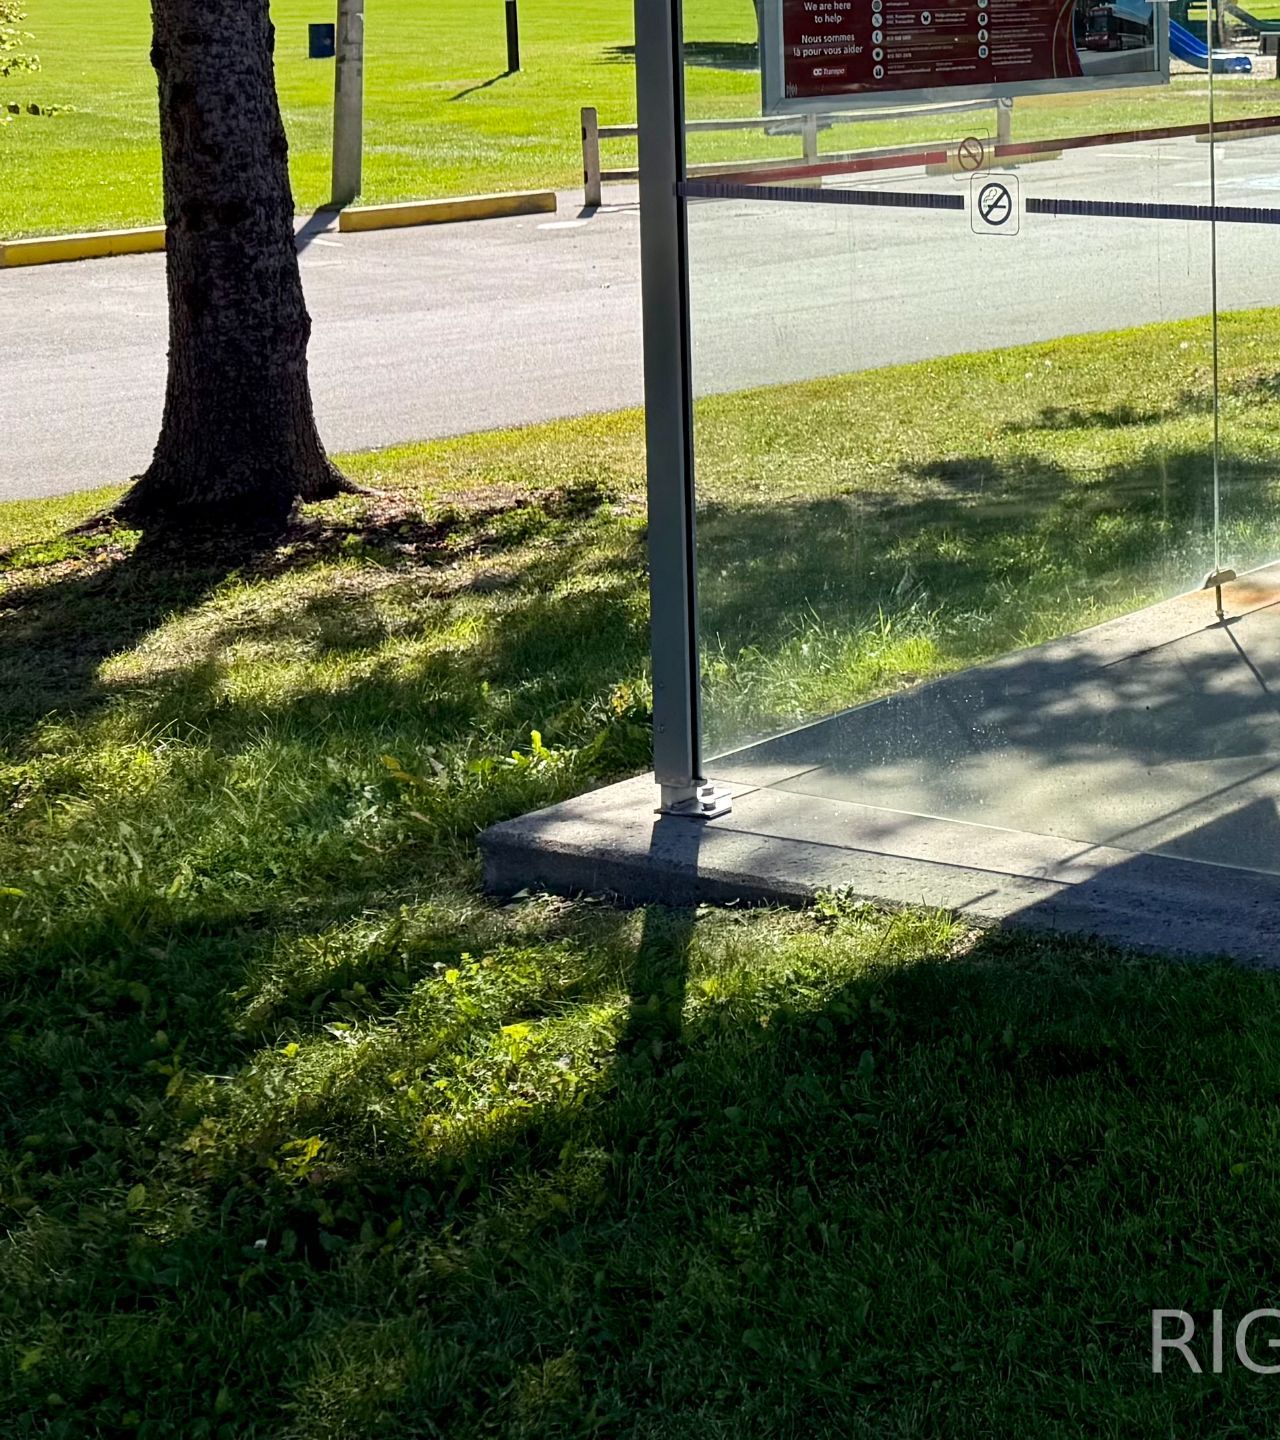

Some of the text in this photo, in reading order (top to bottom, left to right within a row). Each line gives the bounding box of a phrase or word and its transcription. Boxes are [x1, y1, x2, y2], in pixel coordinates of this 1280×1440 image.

[803, 0, 851, 11] We are here
[814, 13, 842, 24] to help
[801, 33, 855, 44] Nous sommes
[802, 48, 822, 58] pour
[823, 47, 842, 55] vous
[843, 44, 864, 54] aider
